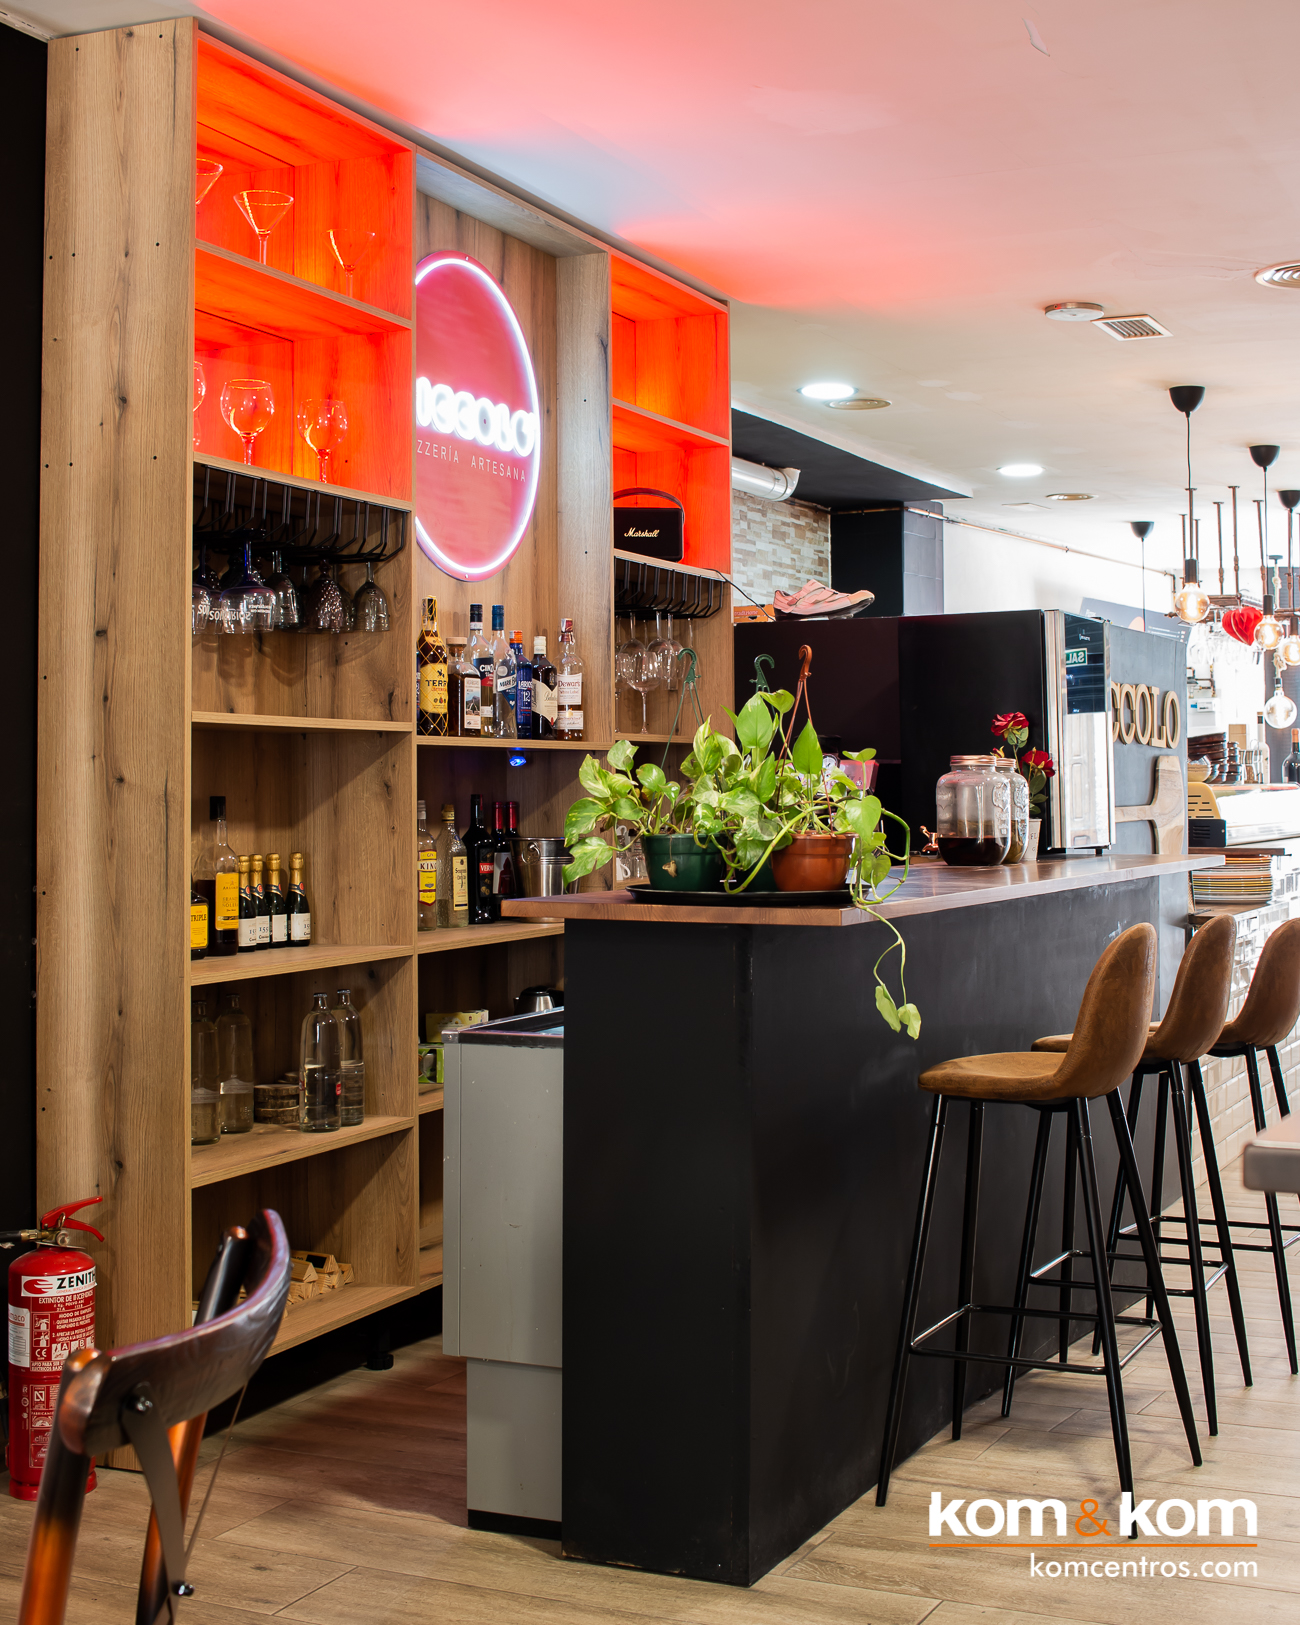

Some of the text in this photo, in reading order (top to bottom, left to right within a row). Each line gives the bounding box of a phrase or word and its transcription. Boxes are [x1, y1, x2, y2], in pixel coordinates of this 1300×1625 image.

[417, 439, 526, 482] ZZERÍA ARTESANA
[624, 527, 660, 537] Marshall
[523, 691, 531, 701] 12
[56, 1270, 95, 1289] ZENITH
[39, 1296, 64, 1304] EXTINTOR
[35, 1348, 47, 1357] CE
